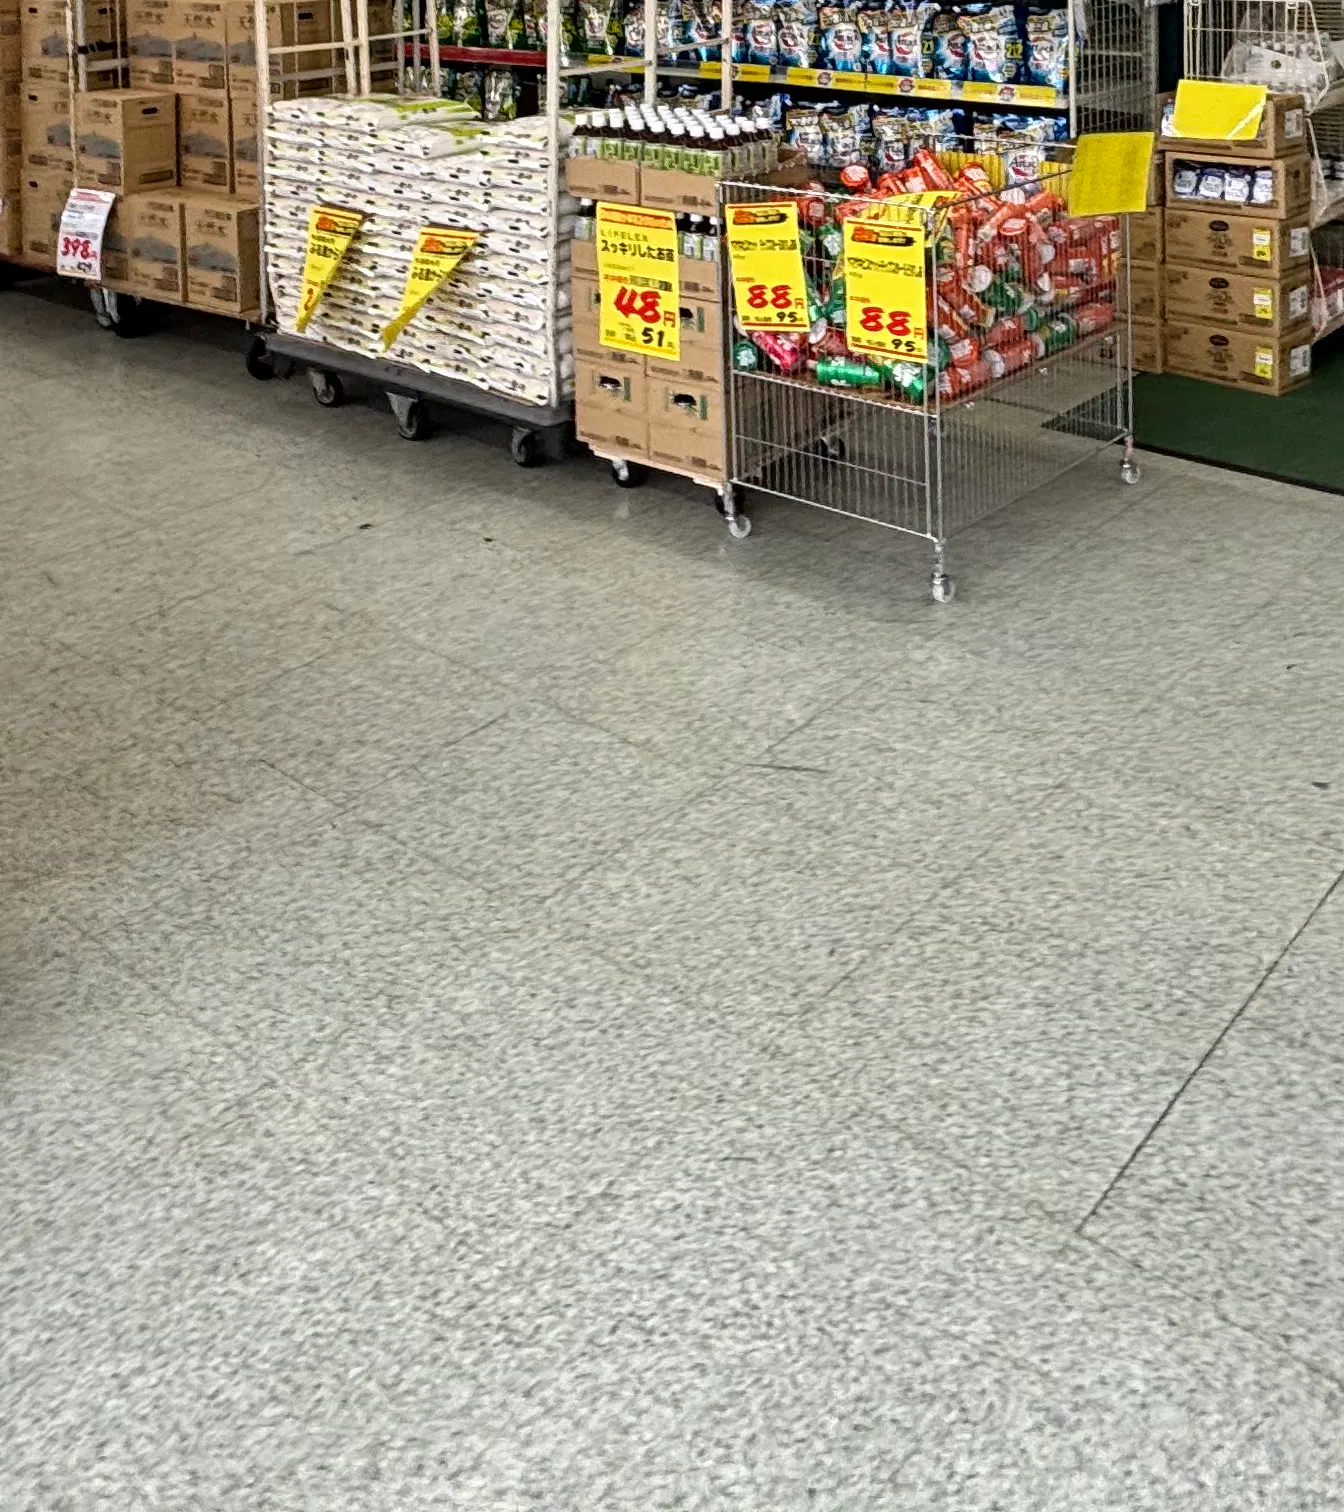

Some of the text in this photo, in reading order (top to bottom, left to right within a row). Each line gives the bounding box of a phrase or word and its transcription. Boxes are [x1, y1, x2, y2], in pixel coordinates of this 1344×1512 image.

[776, 311, 798, 323] 95
[641, 326, 665, 348] 51
[891, 338, 916, 353] 95
